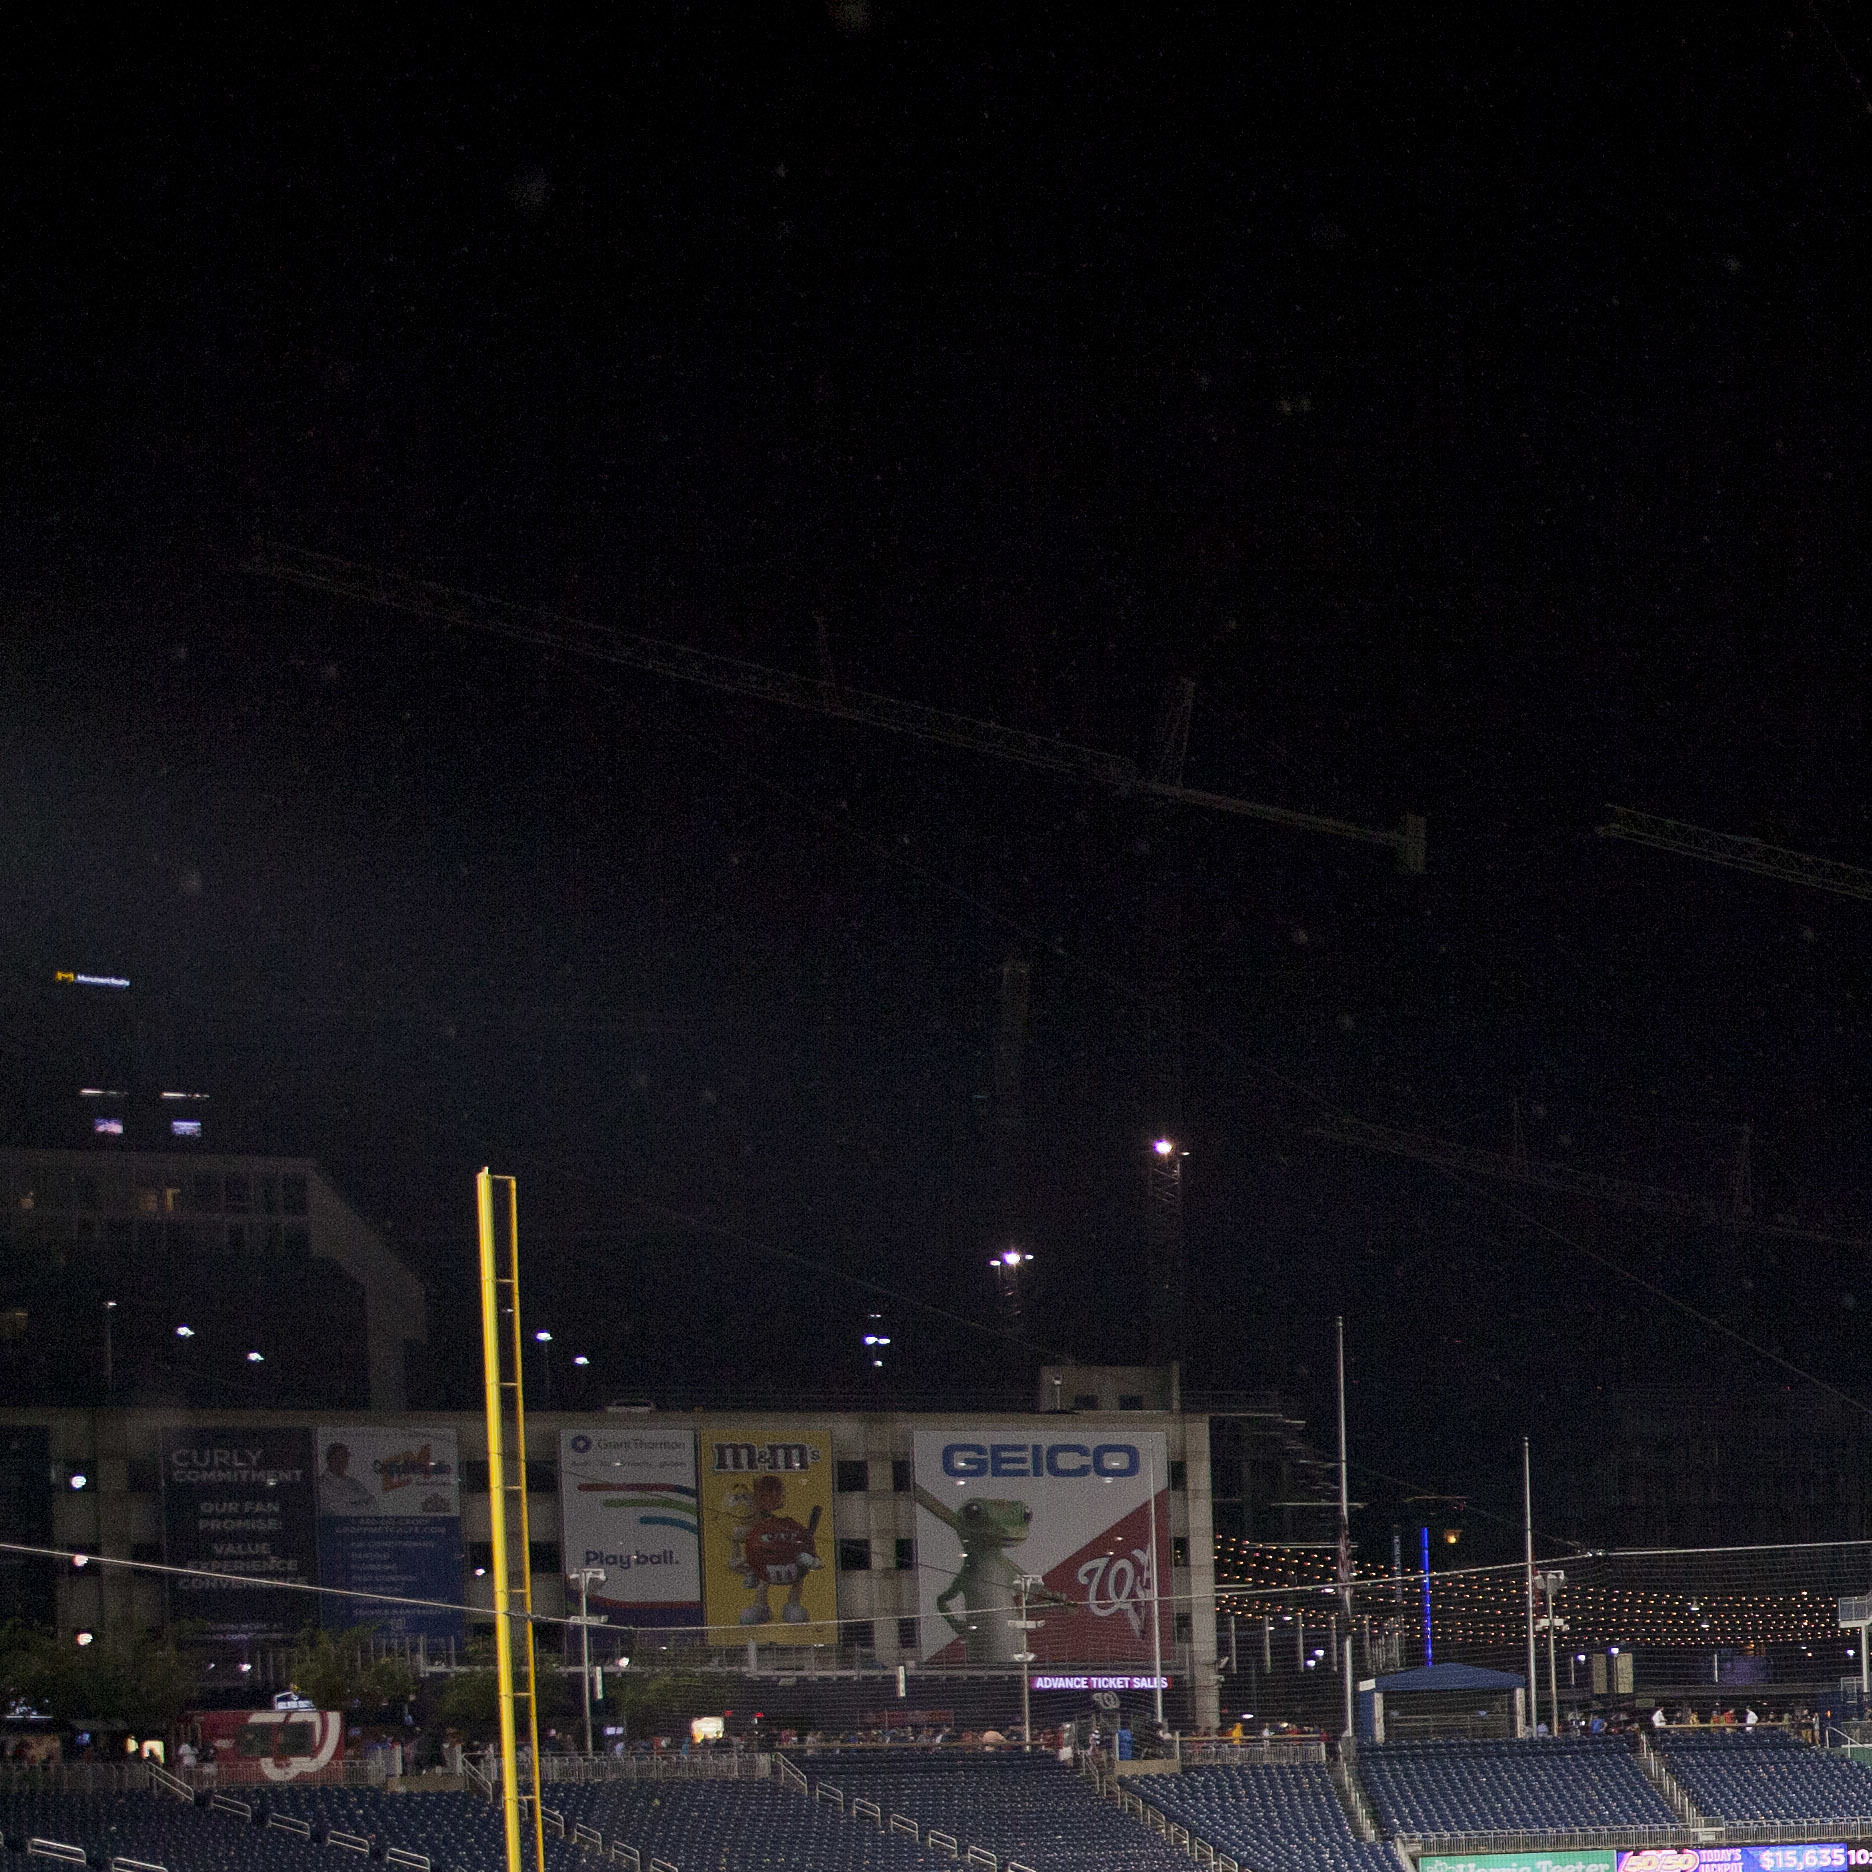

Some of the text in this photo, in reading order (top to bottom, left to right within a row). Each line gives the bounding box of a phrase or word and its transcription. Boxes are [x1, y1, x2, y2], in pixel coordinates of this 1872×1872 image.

[171, 1447, 262, 1467] CURLY
[942, 1443, 1141, 1478] GEICO
[172, 1468, 303, 1484] COMMITMENT
[585, 1550, 632, 1570] Play
[1035, 1676, 1168, 1689] ADVANCE TICKET SALES
[1699, 1848, 1742, 1863] TODAY'S
[1759, 1848, 1846, 1872] $15,635
